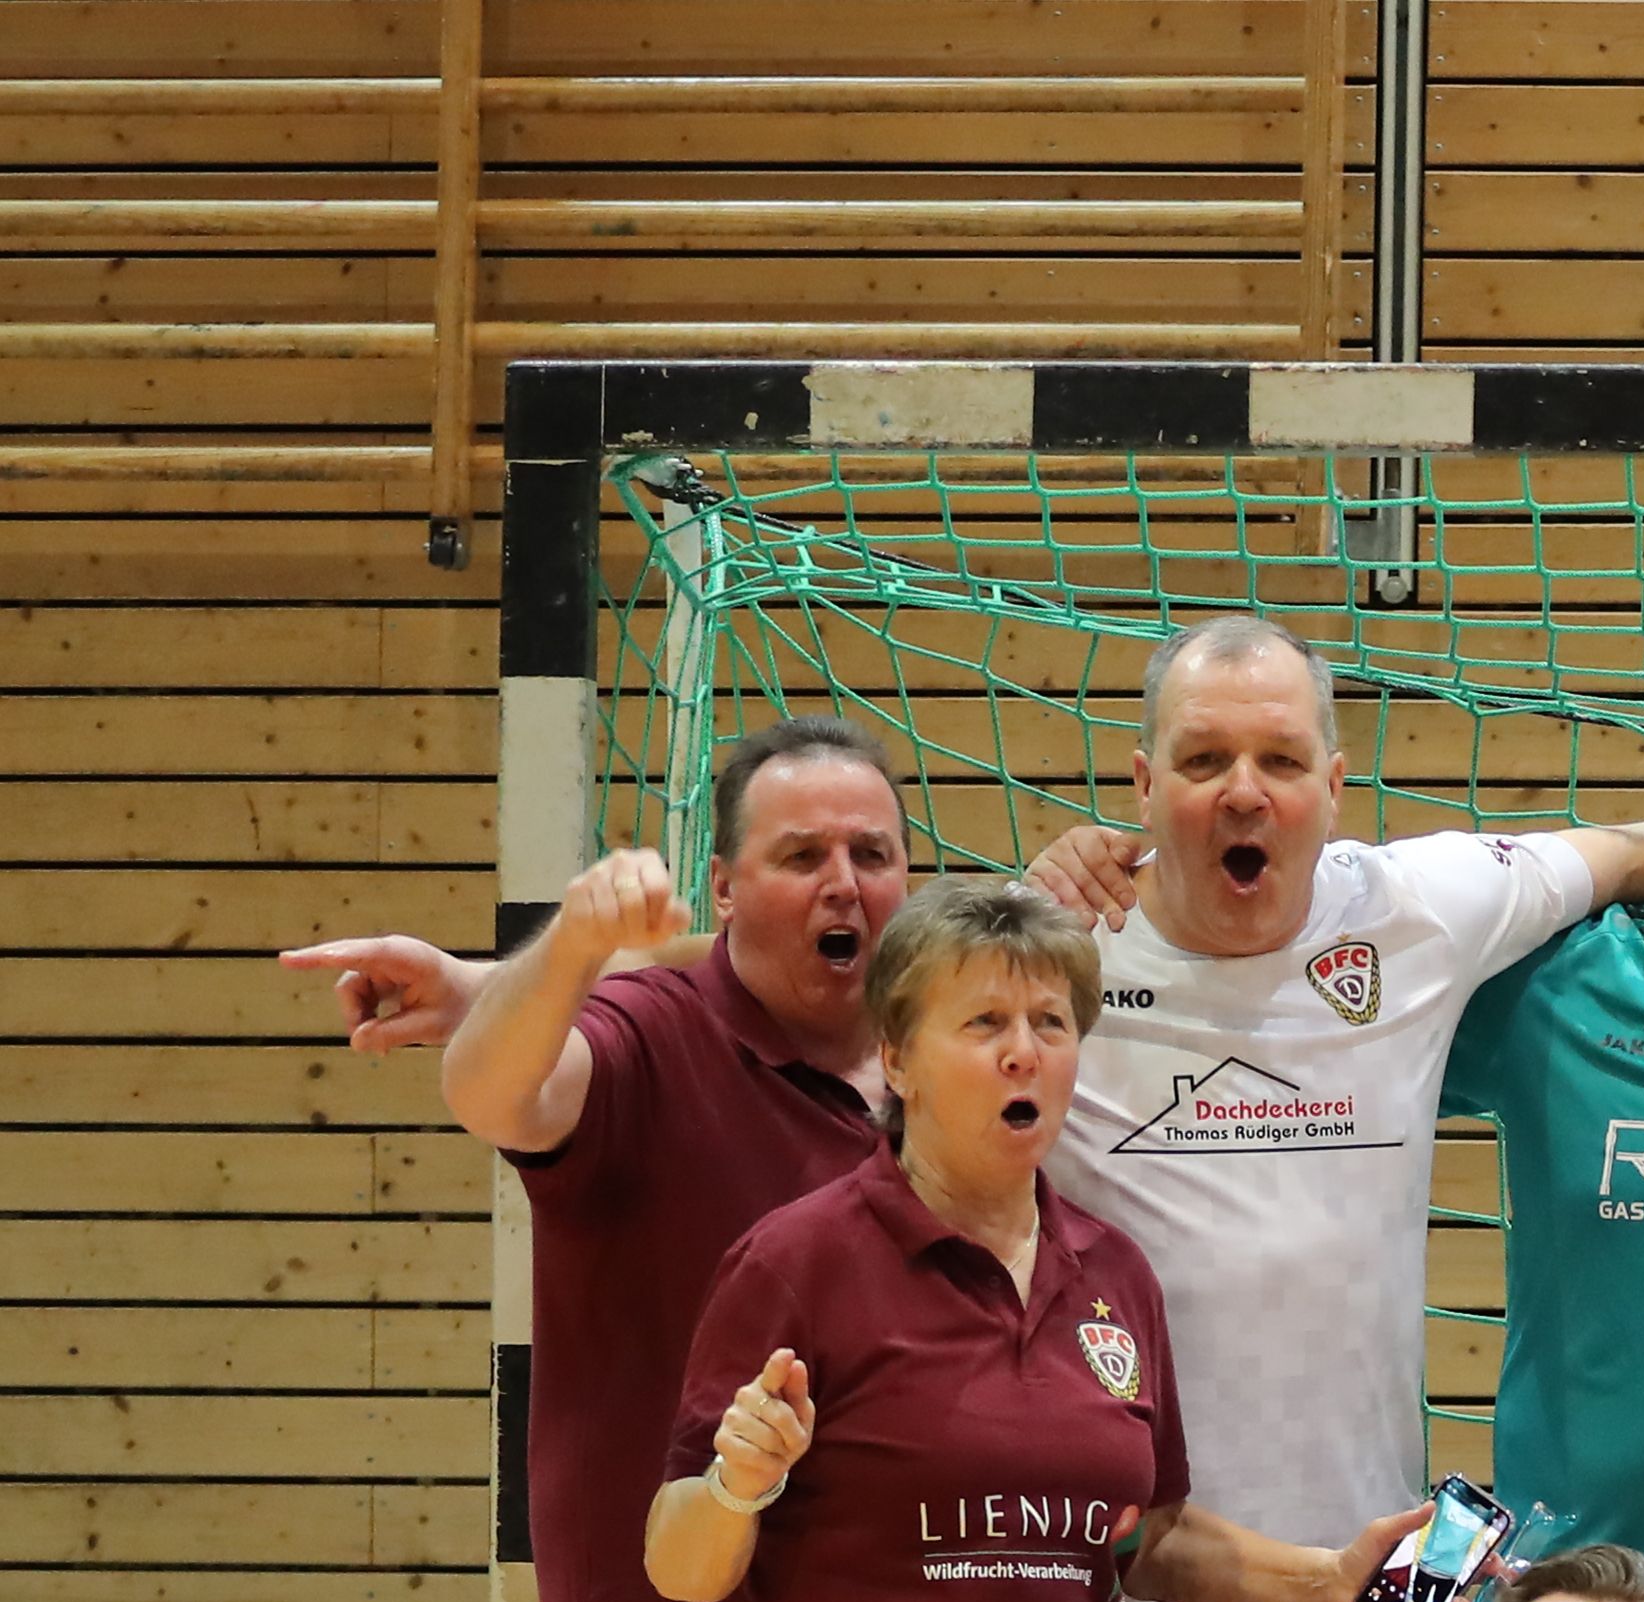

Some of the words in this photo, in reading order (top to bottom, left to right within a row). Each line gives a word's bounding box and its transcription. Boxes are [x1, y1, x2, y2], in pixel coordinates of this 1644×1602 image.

[1314, 947, 1369, 980] BFC
[1194, 1095, 1354, 1121] Dachdeckerei
[1164, 1125, 1229, 1142] Thomas
[1234, 1124, 1300, 1144] Rüdiger
[1305, 1121, 1355, 1137] GmbH
[1599, 1200, 1644, 1221] GAS
[1082, 1326, 1135, 1353] BFC
[919, 1493, 1109, 1545] LIENIG
[922, 1560, 1093, 1587] Wildfrucht-Verarbeitung
